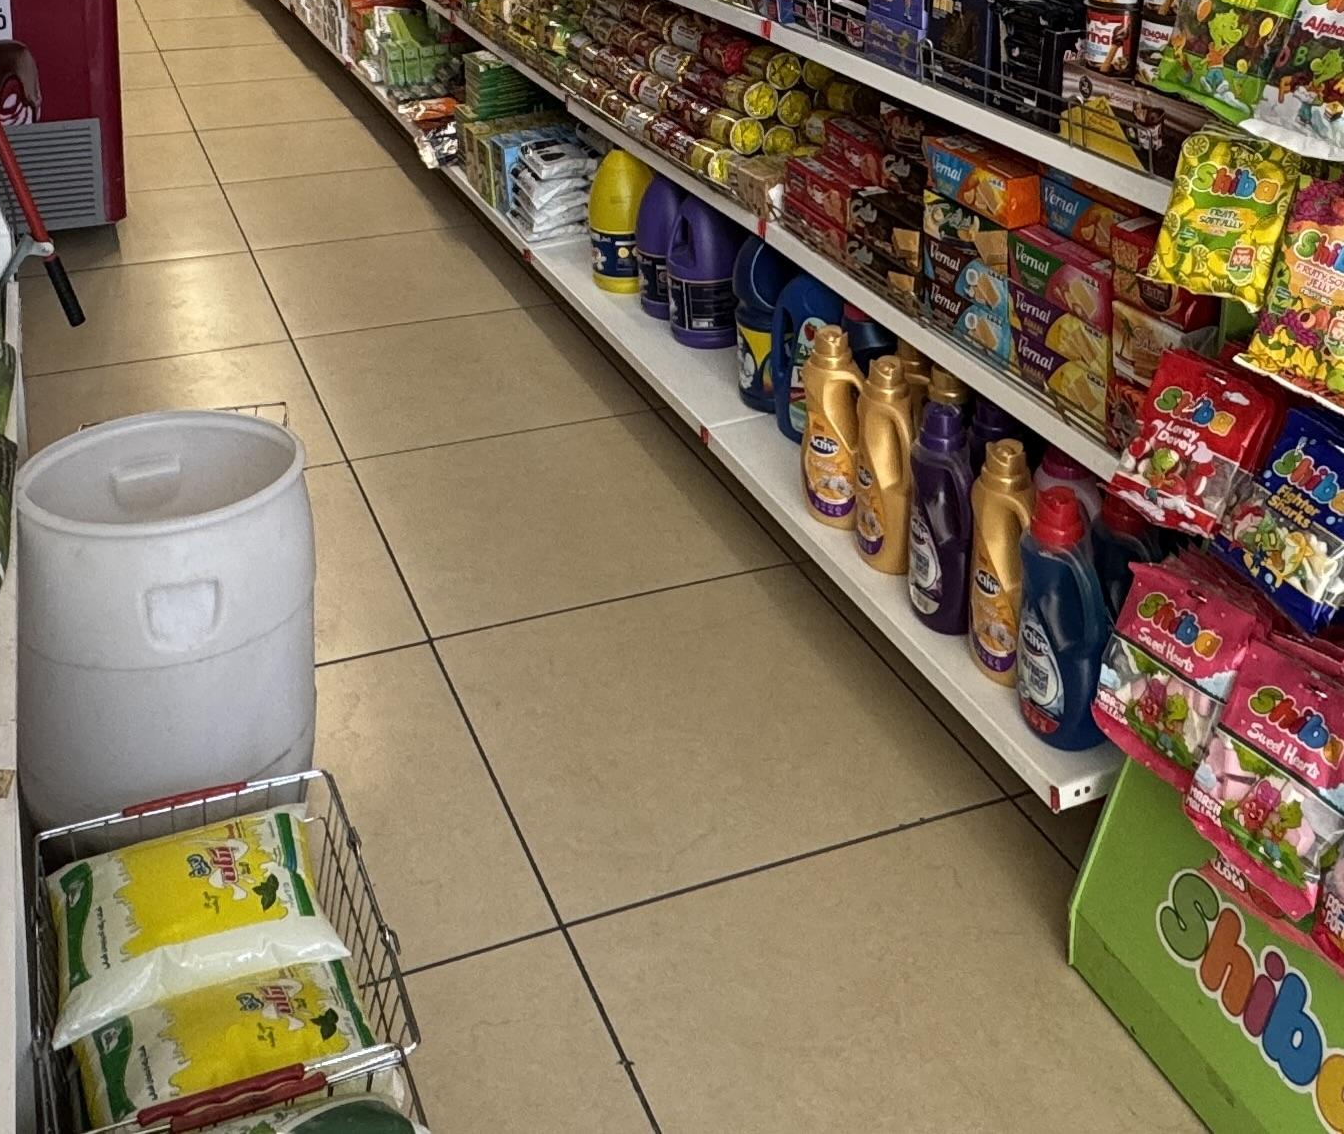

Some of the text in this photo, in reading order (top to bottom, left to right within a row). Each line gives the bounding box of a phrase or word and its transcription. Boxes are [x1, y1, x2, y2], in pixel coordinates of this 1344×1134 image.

[1043, 182, 1081, 217] Vernal
[1190, 161, 1281, 205] Shiba
[1015, 241, 1050, 276] Vernal
[1015, 289, 1053, 324] Vernal
[1017, 334, 1055, 371] Vernal
[1152, 382, 1238, 440] Shiba
[1266, 494, 1313, 532] Sharks
[1275, 482, 1322, 519] Fighter
[1136, 591, 1225, 663] Shiba
[1246, 722, 1321, 780] Sweet Hearts
